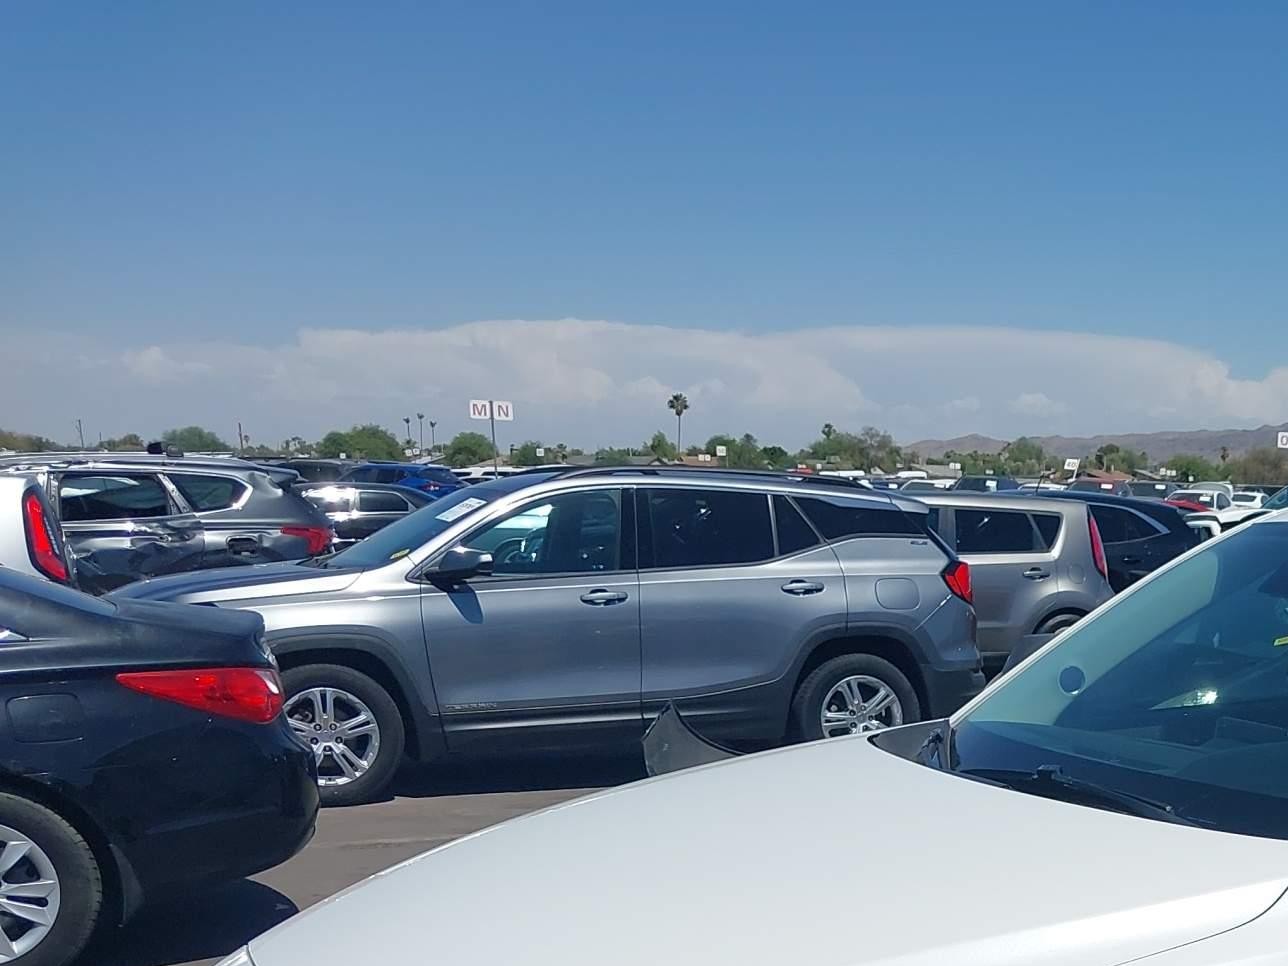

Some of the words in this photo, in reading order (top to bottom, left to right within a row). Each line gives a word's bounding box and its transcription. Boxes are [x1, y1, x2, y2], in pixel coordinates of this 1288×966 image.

[472, 403, 487, 416] M
[497, 404, 509, 417] N
[1280, 435, 1288, 446] O
